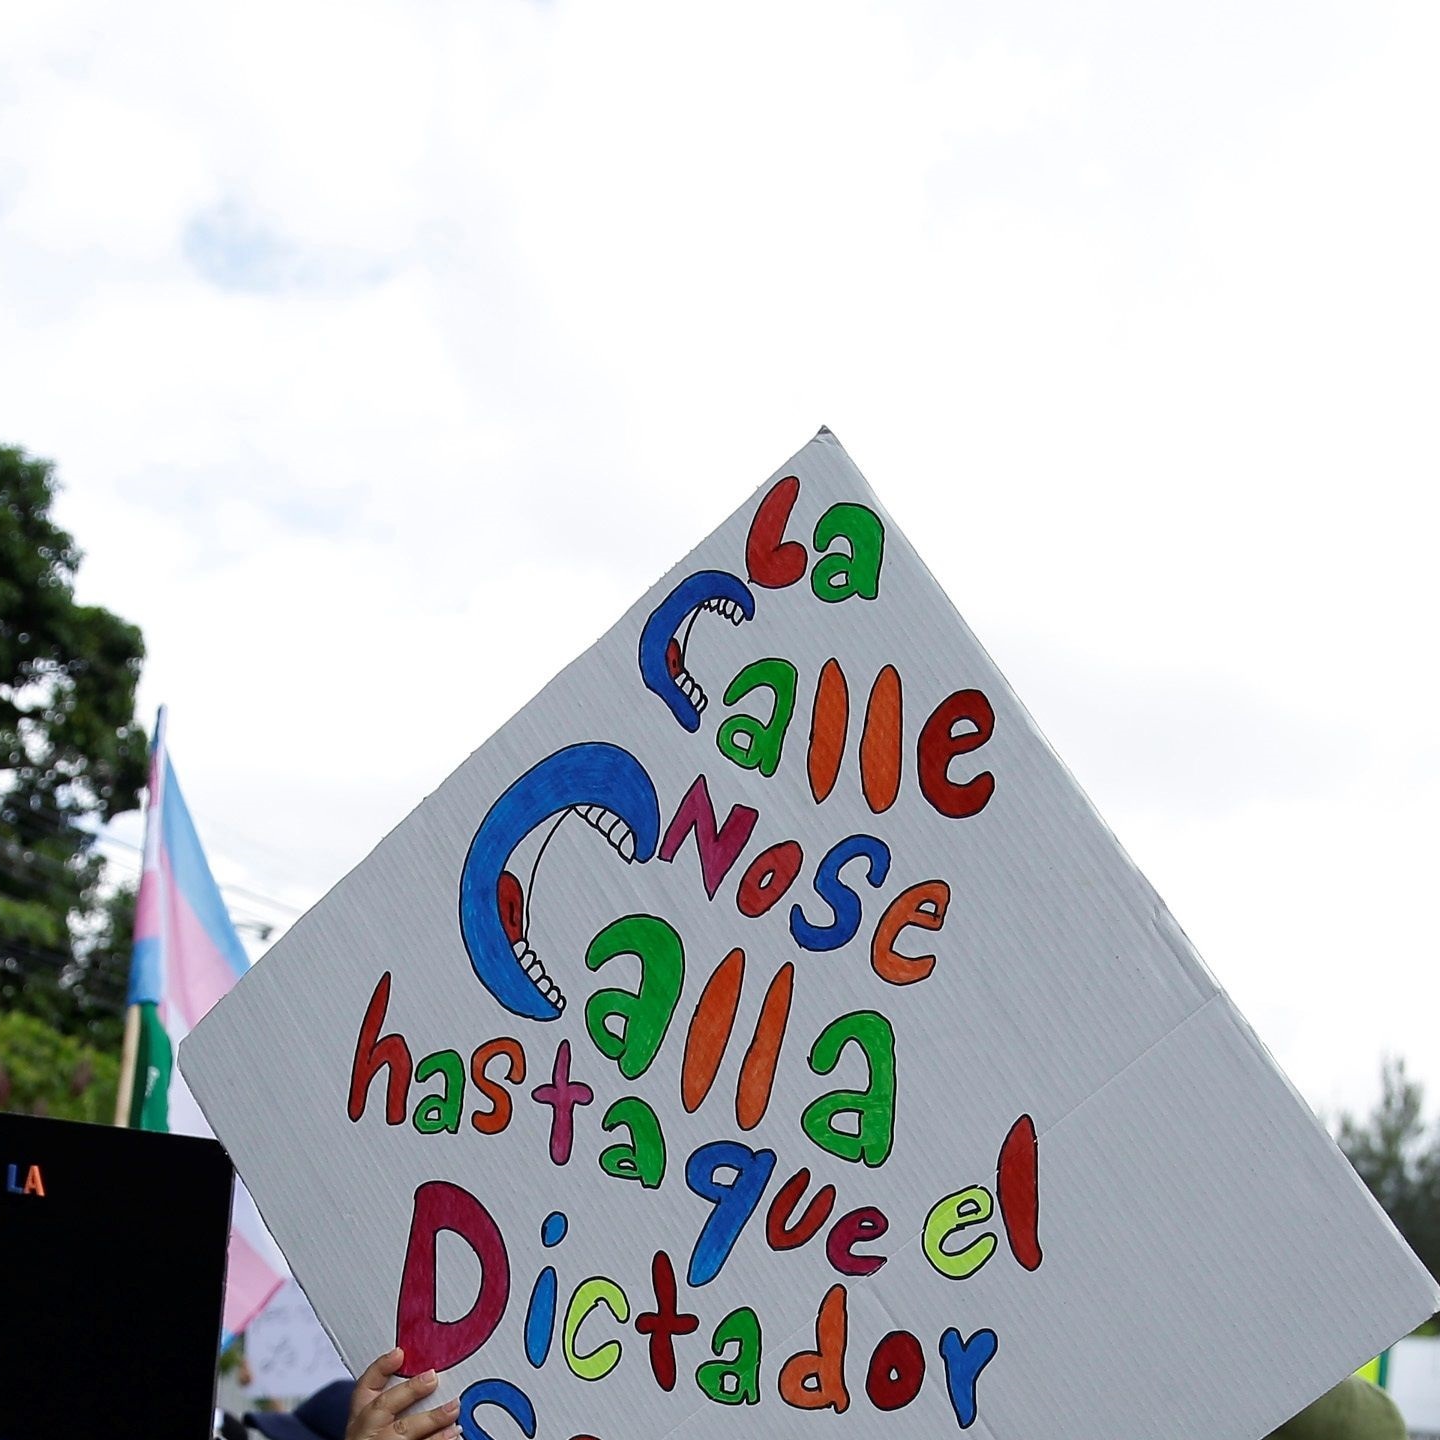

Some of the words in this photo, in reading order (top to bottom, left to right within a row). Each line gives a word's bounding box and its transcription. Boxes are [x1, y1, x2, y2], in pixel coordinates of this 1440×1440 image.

[745, 475, 885, 603] La
[638, 569, 996, 818] Calle
[459, 740, 897, 1167] Calla
[6, 1163, 47, 1198] LA
[395, 1180, 999, 1430] Dictador
